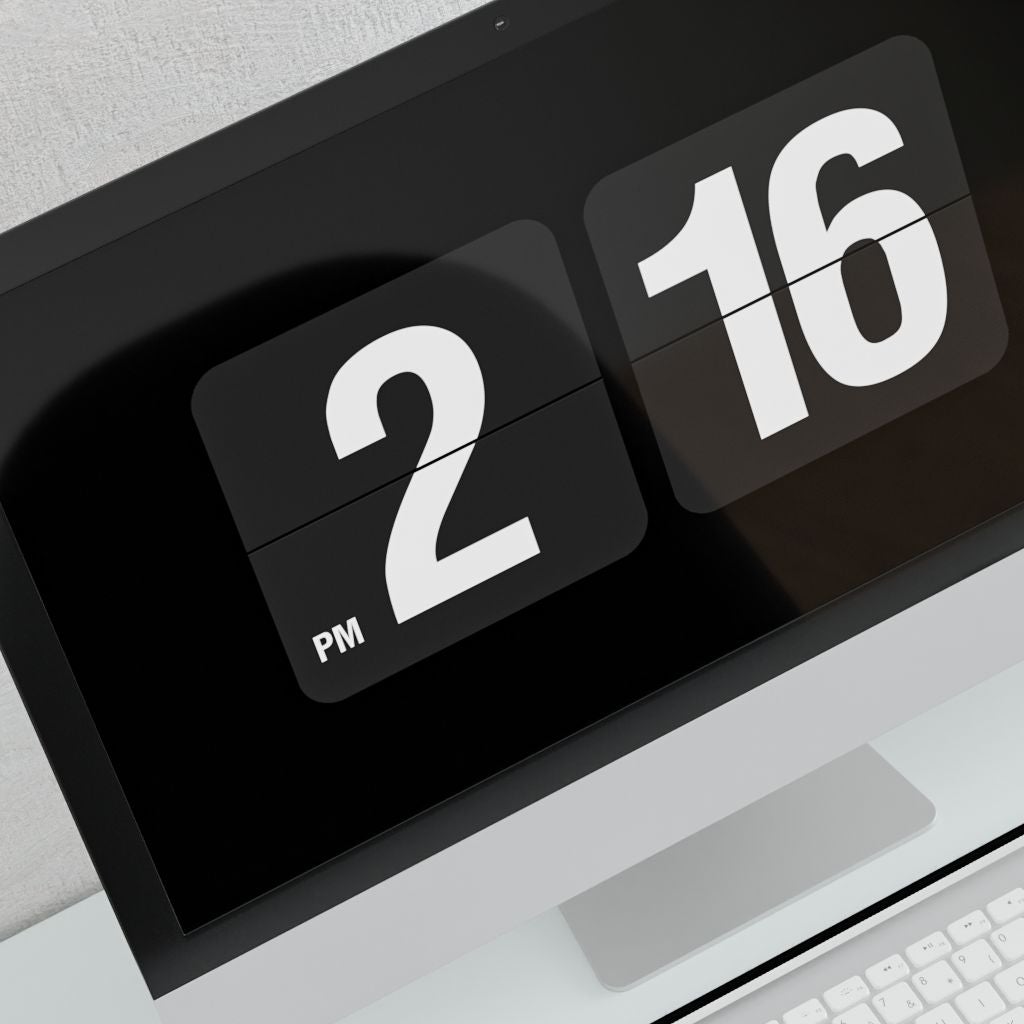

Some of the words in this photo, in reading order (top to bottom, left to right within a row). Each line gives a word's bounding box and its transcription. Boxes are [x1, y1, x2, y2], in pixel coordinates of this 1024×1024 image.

[325, 325, 541, 625] 2
[637, 107, 948, 440] 16
[312, 616, 365, 663] PM
[878, 996, 886, 1008] 7
[918, 976, 929, 986] 8
[957, 954, 967, 965] 9
[997, 932, 1008, 945] 0
[977, 998, 985, 1008] I
